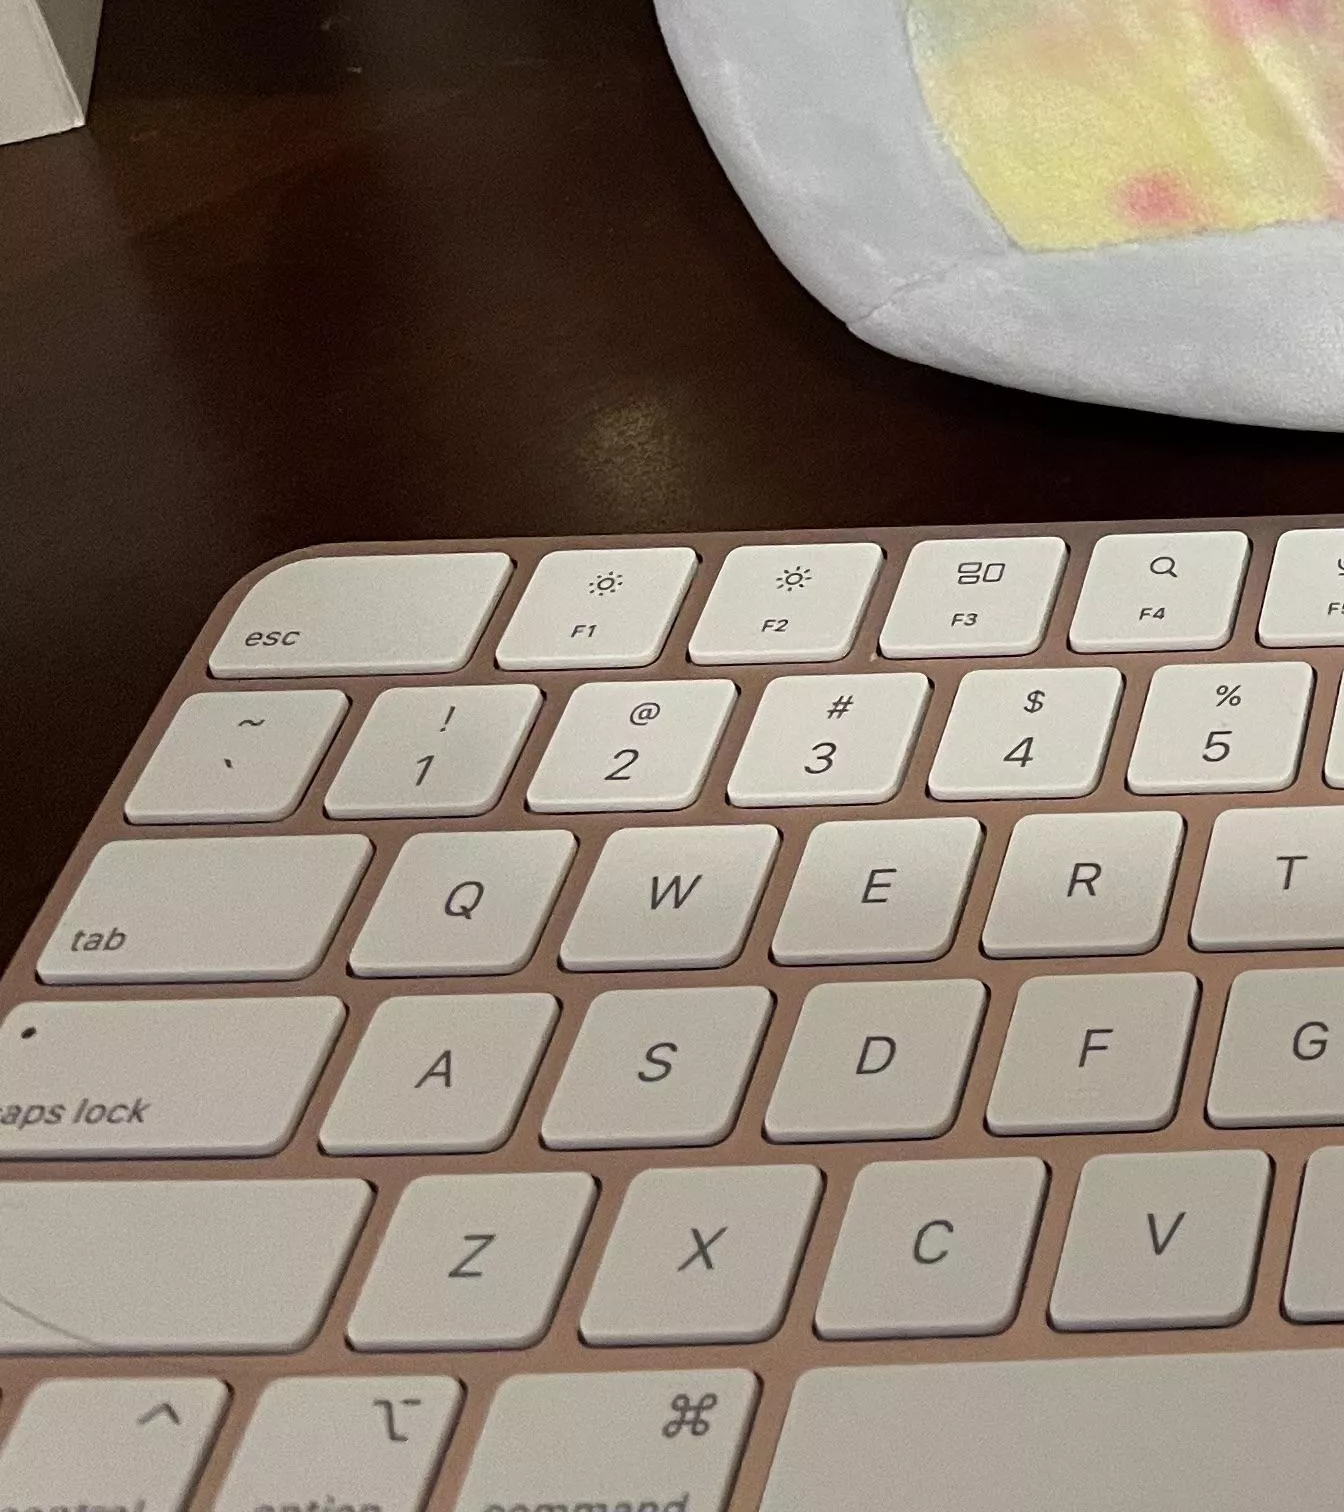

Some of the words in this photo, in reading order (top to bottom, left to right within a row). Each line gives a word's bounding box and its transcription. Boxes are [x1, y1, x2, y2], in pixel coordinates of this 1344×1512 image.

[570, 624, 597, 638] F1
[761, 618, 789, 633] F2
[950, 612, 979, 627] F3
[1138, 607, 1166, 621] F4
[244, 630, 301, 647] esc
[827, 695, 854, 719] #
[1023, 689, 1046, 714] $
[1215, 684, 1242, 707] %
[439, 705, 456, 733] !
[629, 702, 661, 727] @
[804, 741, 837, 775] 3
[1003, 736, 1034, 768] 4
[1202, 730, 1233, 763] 5
[415, 754, 435, 787] 1
[603, 748, 640, 781] 2
[861, 868, 898, 904] E
[1066, 862, 1102, 898] R
[1276, 855, 1309, 891] T
[444, 880, 485, 920] Q
[650, 874, 703, 911] W
[70, 927, 127, 953] tab
[855, 1035, 897, 1075] D
[1078, 1028, 1114, 1068] F
[1292, 1020, 1329, 1061] G
[414, 1049, 452, 1089] A
[637, 1041, 678, 1083] S
[0, 1103, 67, 1131] aps
[73, 1097, 150, 1125] lock
[677, 1226, 728, 1272] X
[912, 1219, 954, 1265] C
[1147, 1211, 1187, 1256] V
[447, 1233, 497, 1279] Z
